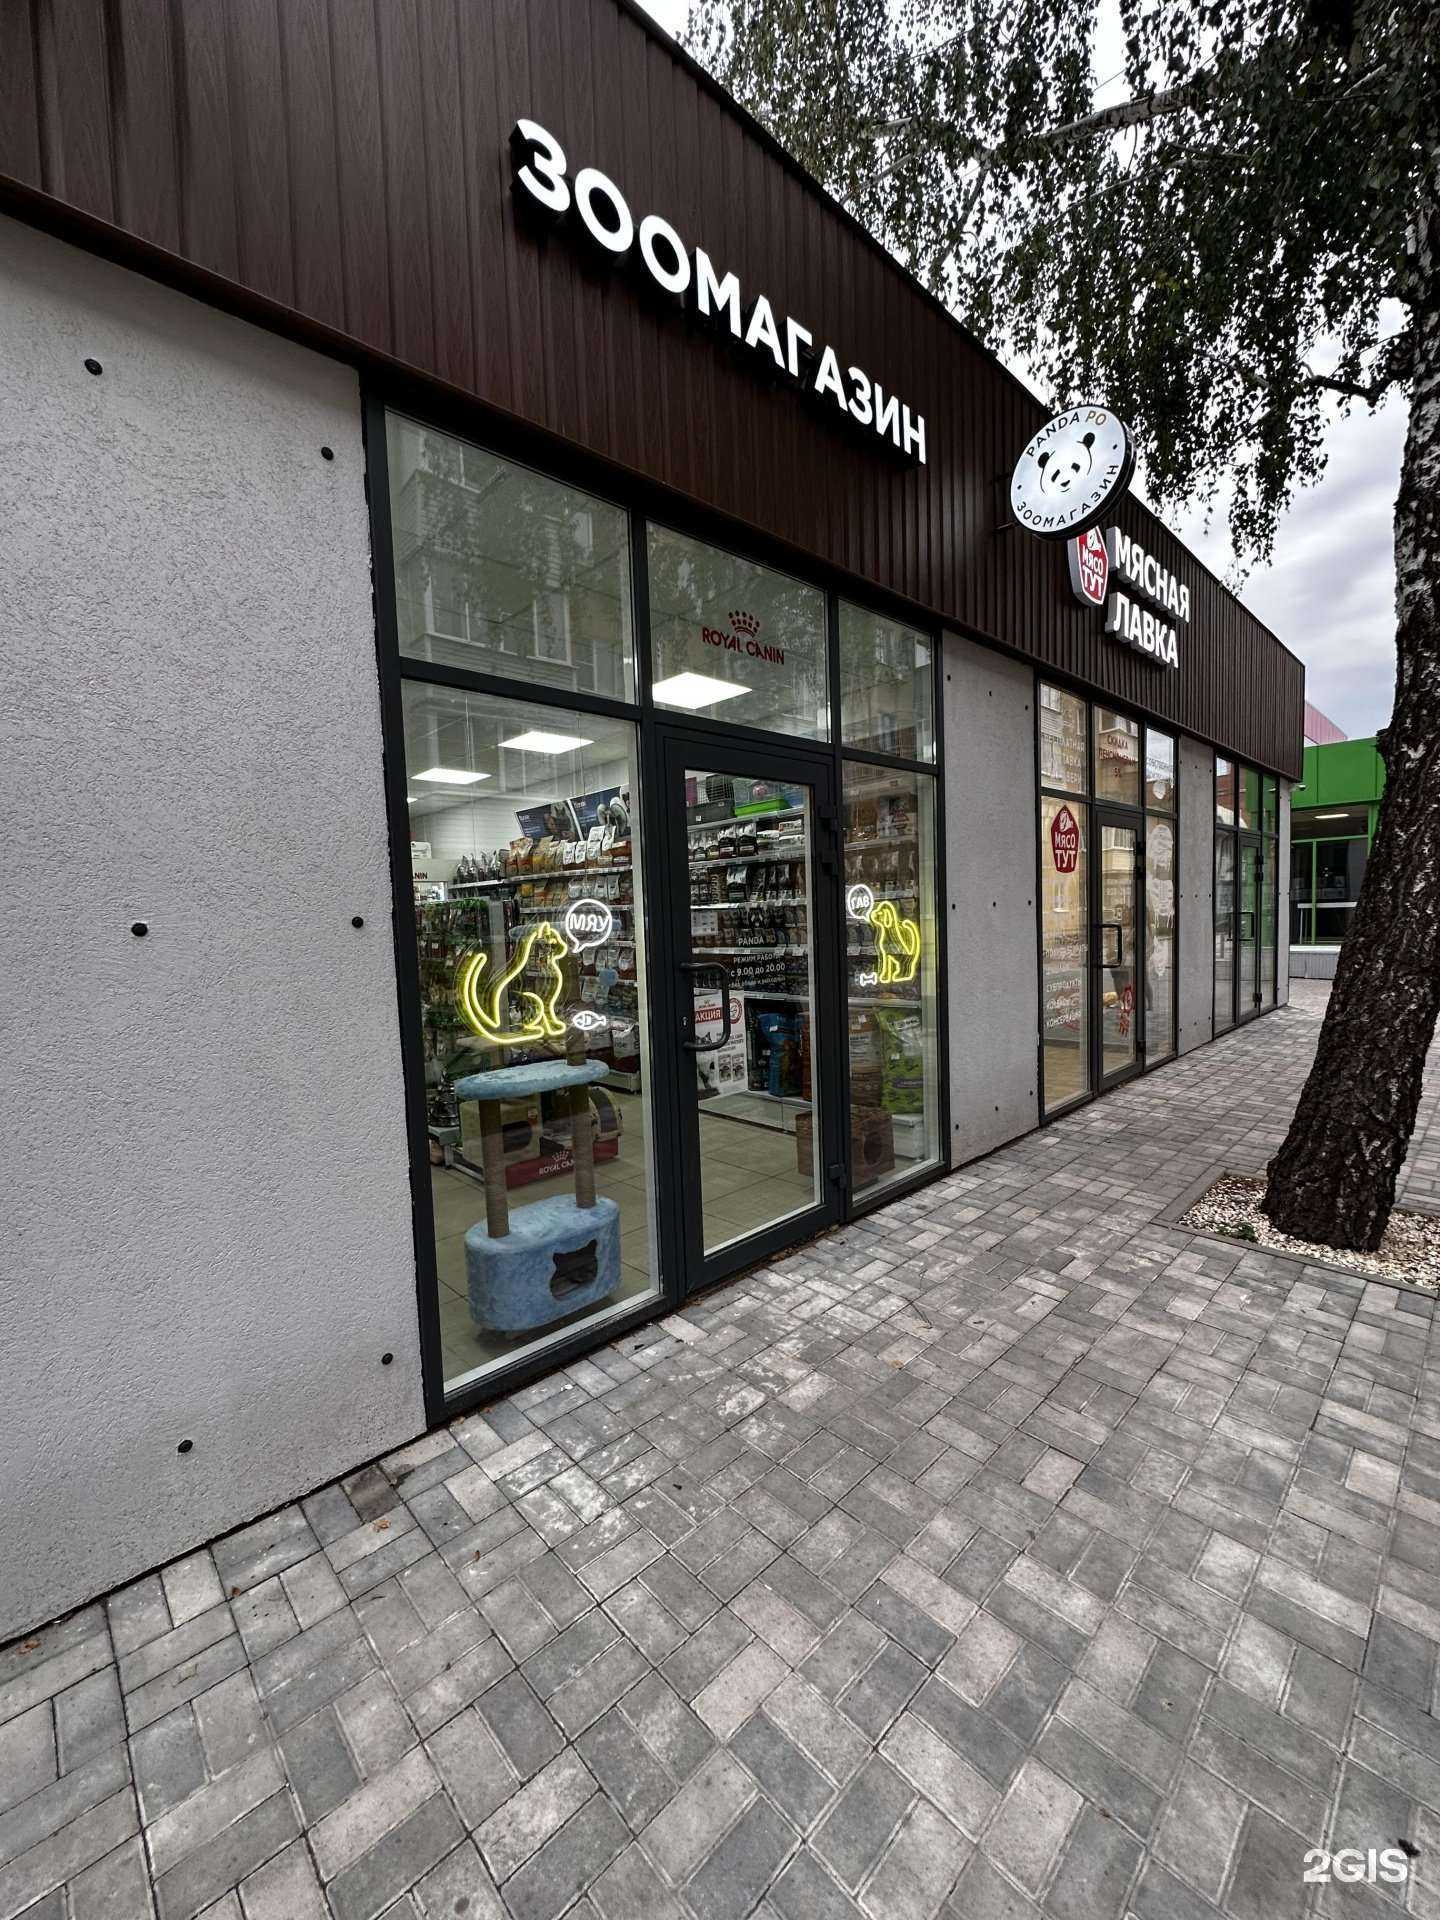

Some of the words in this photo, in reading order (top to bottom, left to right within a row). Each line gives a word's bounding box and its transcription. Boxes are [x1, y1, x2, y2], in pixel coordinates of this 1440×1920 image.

[518, 118, 926, 465] ЗООМАГАЗИН
[1027, 411, 1081, 458] PANDA
[1084, 409, 1108, 427] PO
[1016, 463, 1119, 528] ЗООМАГАЗИН
[1082, 543, 1104, 576] МЯСО
[1113, 526, 1190, 623] МЯСНАЯ
[1082, 564, 1104, 597] ТУТ
[702, 626, 743, 653] ROYAL
[745, 640, 785, 666] CANIN
[1112, 591, 1180, 669] ЛАВКА
[1107, 734, 1129, 750] СКИДКА
[1054, 831, 1076, 849] МЯСО
[1055, 849, 1076, 868] ТУТ
[850, 895, 870, 910] ГАВ
[569, 913, 610, 933] МЯУ
[738, 936, 765, 947] PANDA
[695, 1008, 721, 1023] АКЦИЯ
